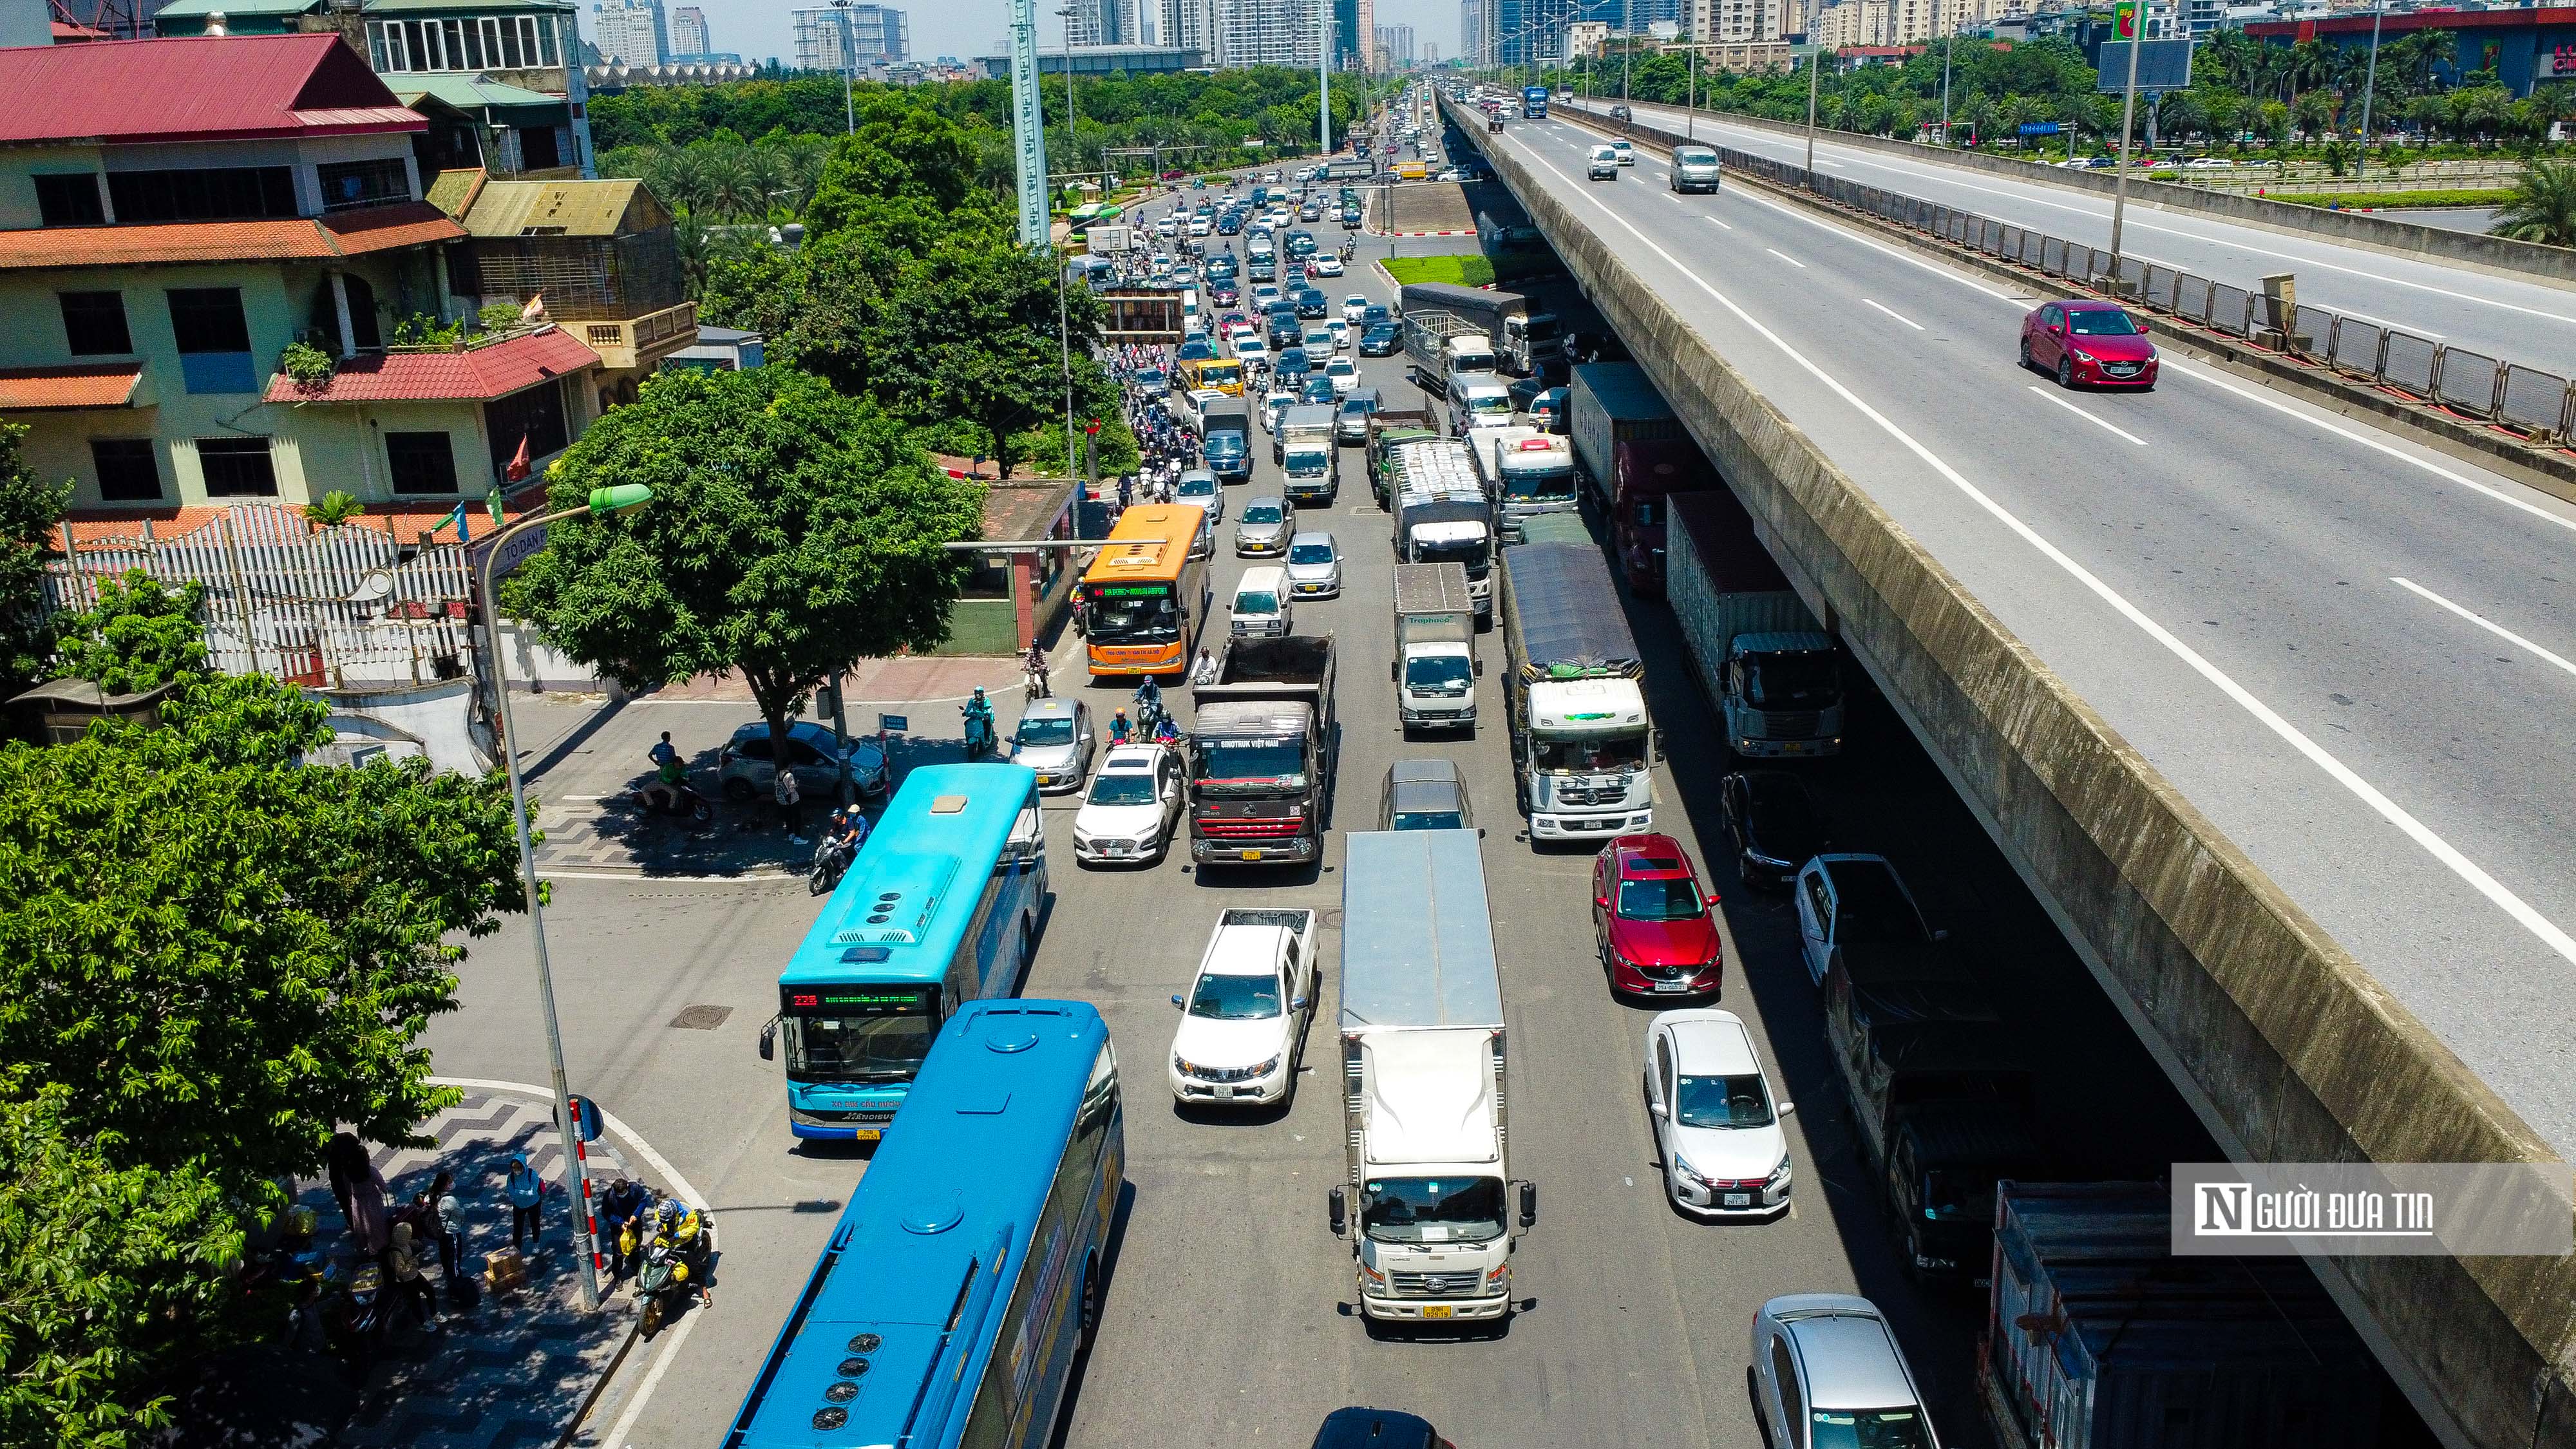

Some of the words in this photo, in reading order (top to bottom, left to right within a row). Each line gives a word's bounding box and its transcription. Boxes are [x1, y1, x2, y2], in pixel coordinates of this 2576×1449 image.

[2119, 9, 2132, 18] Big
[1221, 740, 1251, 748] SINOTRUK
[1251, 738, 1264, 749] VIỆT
[1265, 739, 1279, 748] NAM
[842, 1112, 895, 1121] HANOIBUS
